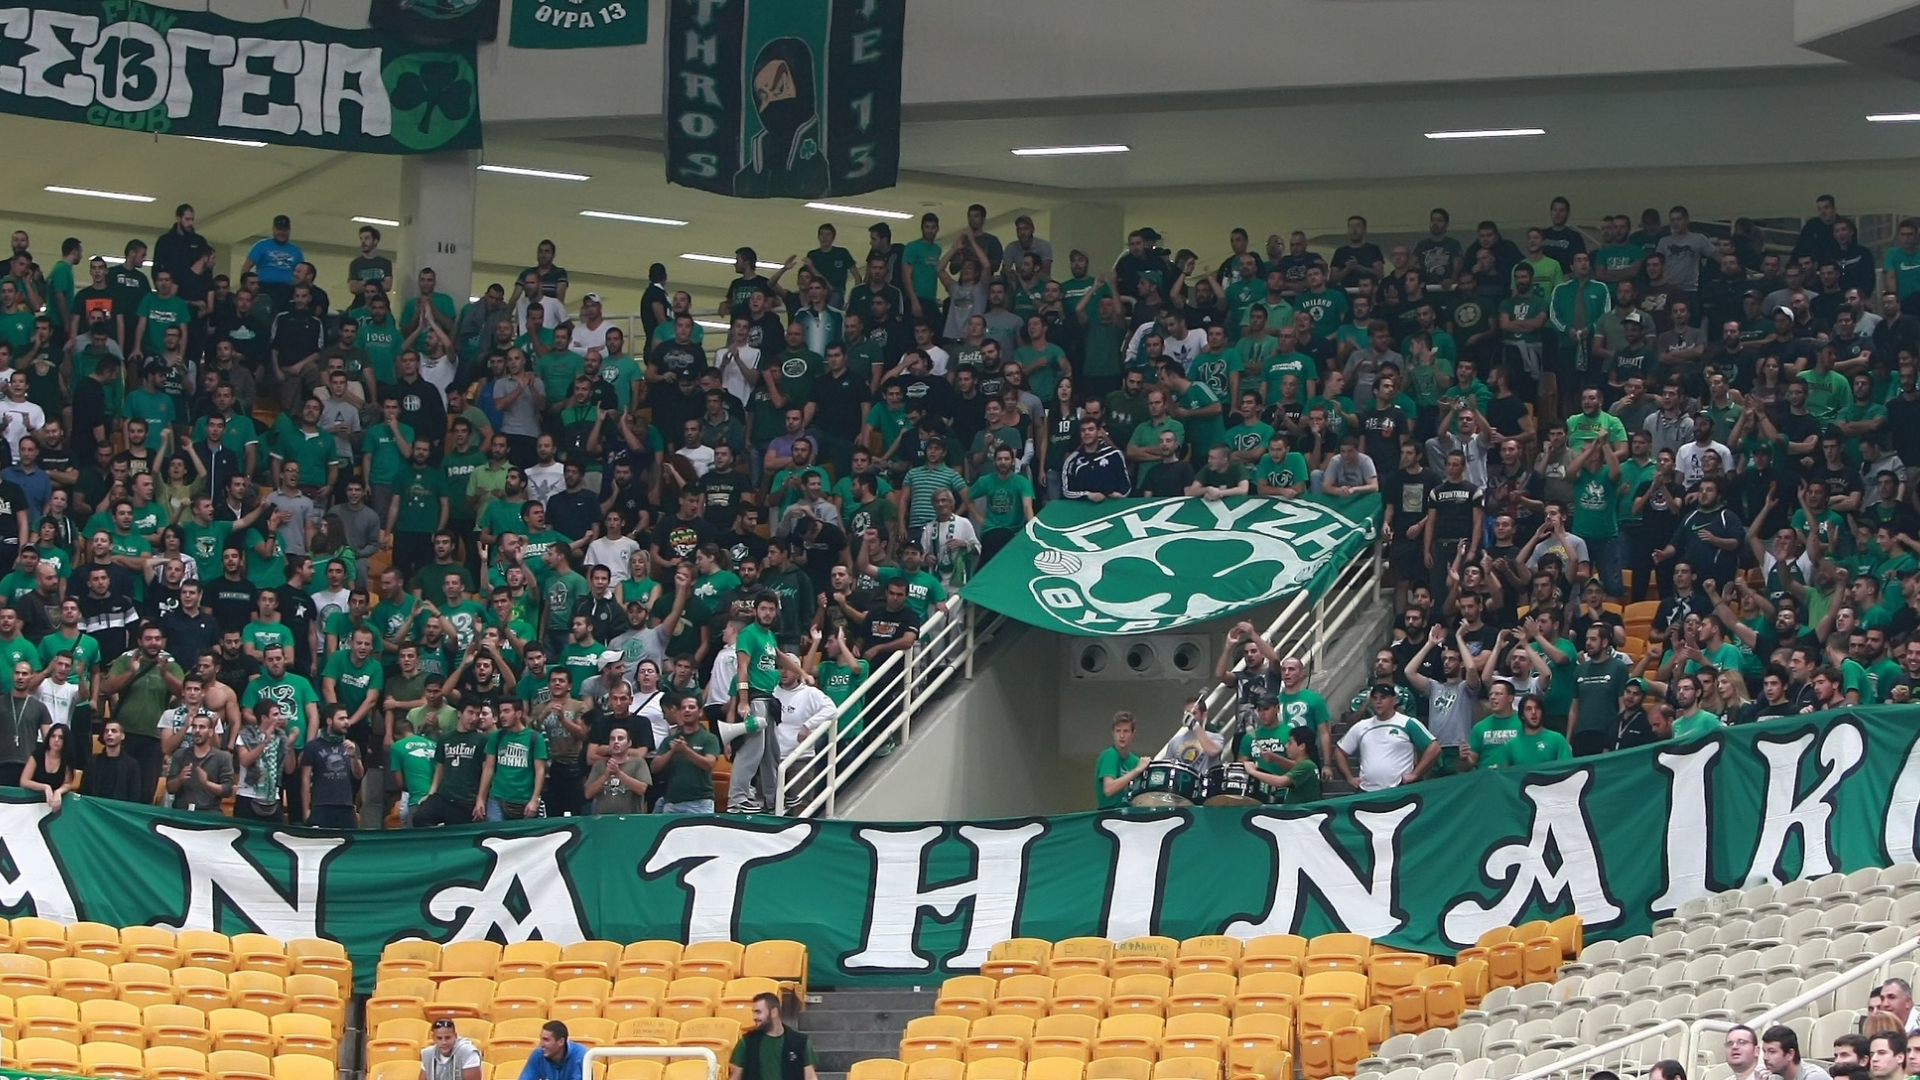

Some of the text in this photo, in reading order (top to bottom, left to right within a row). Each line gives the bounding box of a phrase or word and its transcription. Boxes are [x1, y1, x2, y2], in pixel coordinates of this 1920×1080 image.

[101, 0, 178, 34] FAN
[599, 2, 627, 24] 13
[93, 36, 158, 102] 13
[86, 104, 173, 133] CLUB
[437, 241, 456, 254] 140
[1062, 498, 1347, 559] ΓΚΥΖΗ
